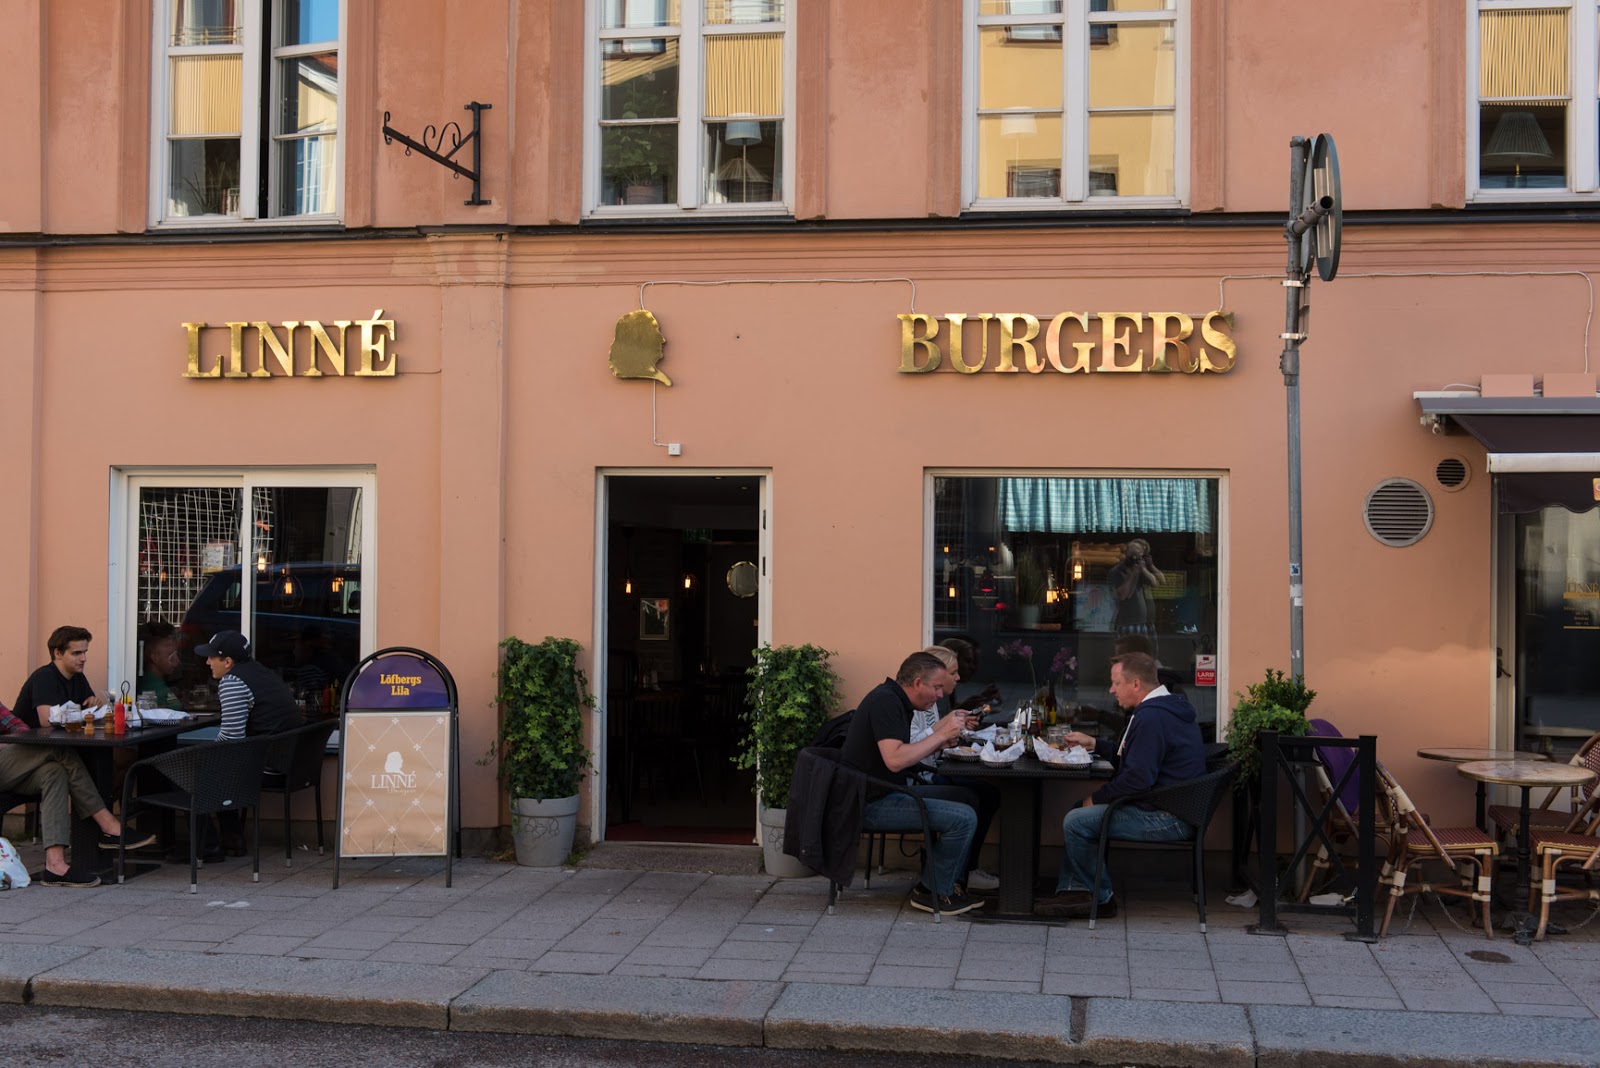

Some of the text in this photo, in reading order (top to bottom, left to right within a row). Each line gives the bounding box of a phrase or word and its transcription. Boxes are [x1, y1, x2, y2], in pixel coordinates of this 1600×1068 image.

[181, 309, 397, 377] LINNÉ
[897, 310, 1237, 374] BURGERS
[380, 674, 421, 686] Löfbergs
[391, 686, 409, 695] Lila
[371, 770, 416, 788] LINNÉ
